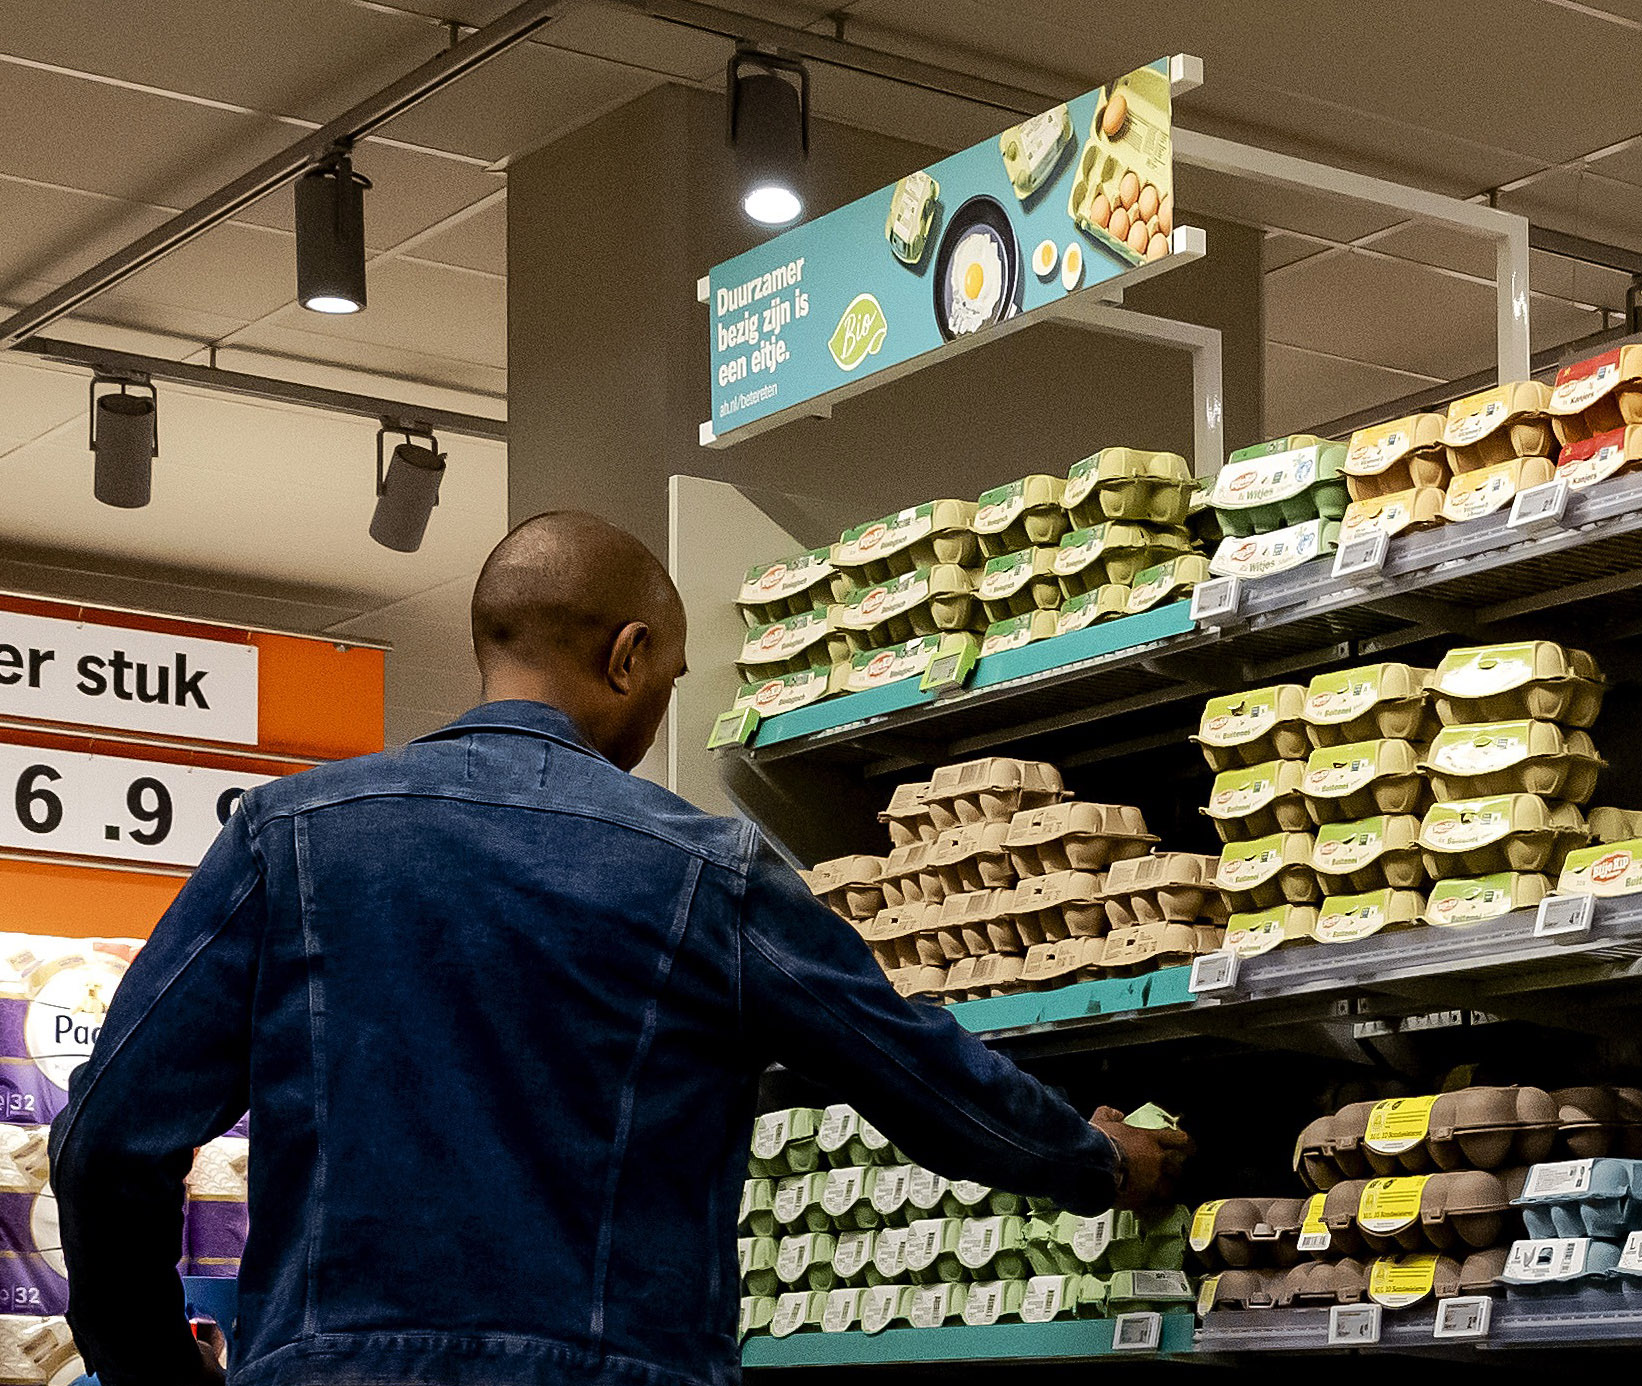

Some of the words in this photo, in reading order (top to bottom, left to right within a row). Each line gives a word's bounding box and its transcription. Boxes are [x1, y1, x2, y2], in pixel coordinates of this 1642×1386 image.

[717, 258, 805, 317] Duurzamer
[718, 312, 759, 352] bezig
[763, 297, 791, 335] zijn
[795, 288, 809, 318] is
[840, 310, 877, 360] Bio
[718, 355, 747, 387] een
[751, 336, 790, 374] eitje.
[0, 643, 55, 688] er
[76, 650, 210, 710] stuk
